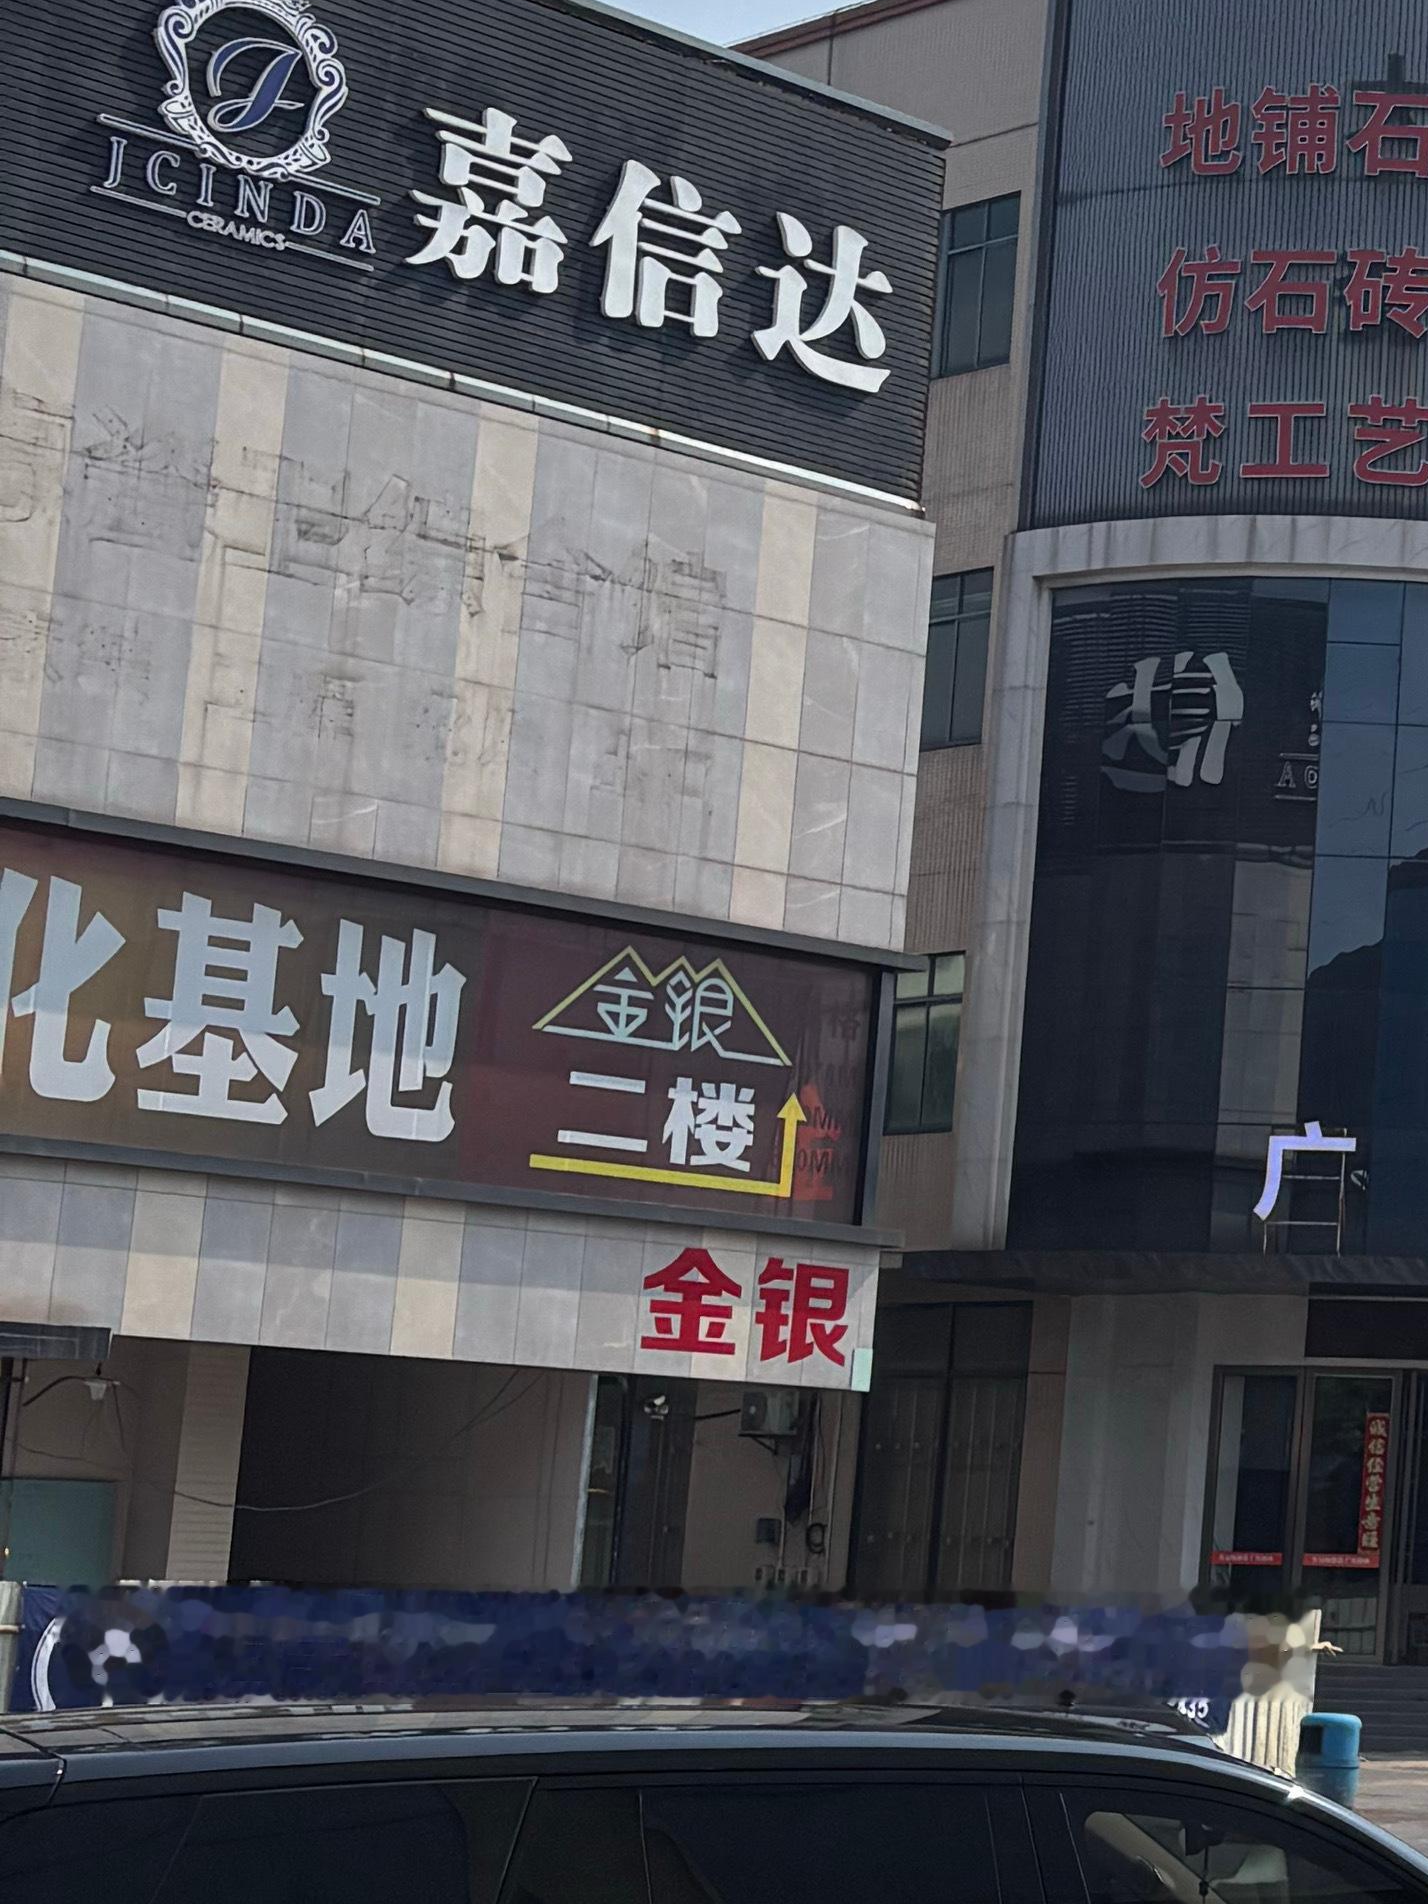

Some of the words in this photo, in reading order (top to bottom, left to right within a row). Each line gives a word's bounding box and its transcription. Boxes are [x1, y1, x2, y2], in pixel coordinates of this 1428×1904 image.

[103, 136, 377, 254] JCINDA
[186, 210, 288, 252] CERAMICS
[405, 107, 893, 394] 嘉信达
[0, 868, 467, 1144] 化基地
[594, 969, 735, 1052] 金银
[557, 1071, 757, 1173] 二楼
[640, 1247, 852, 1368] 金银
